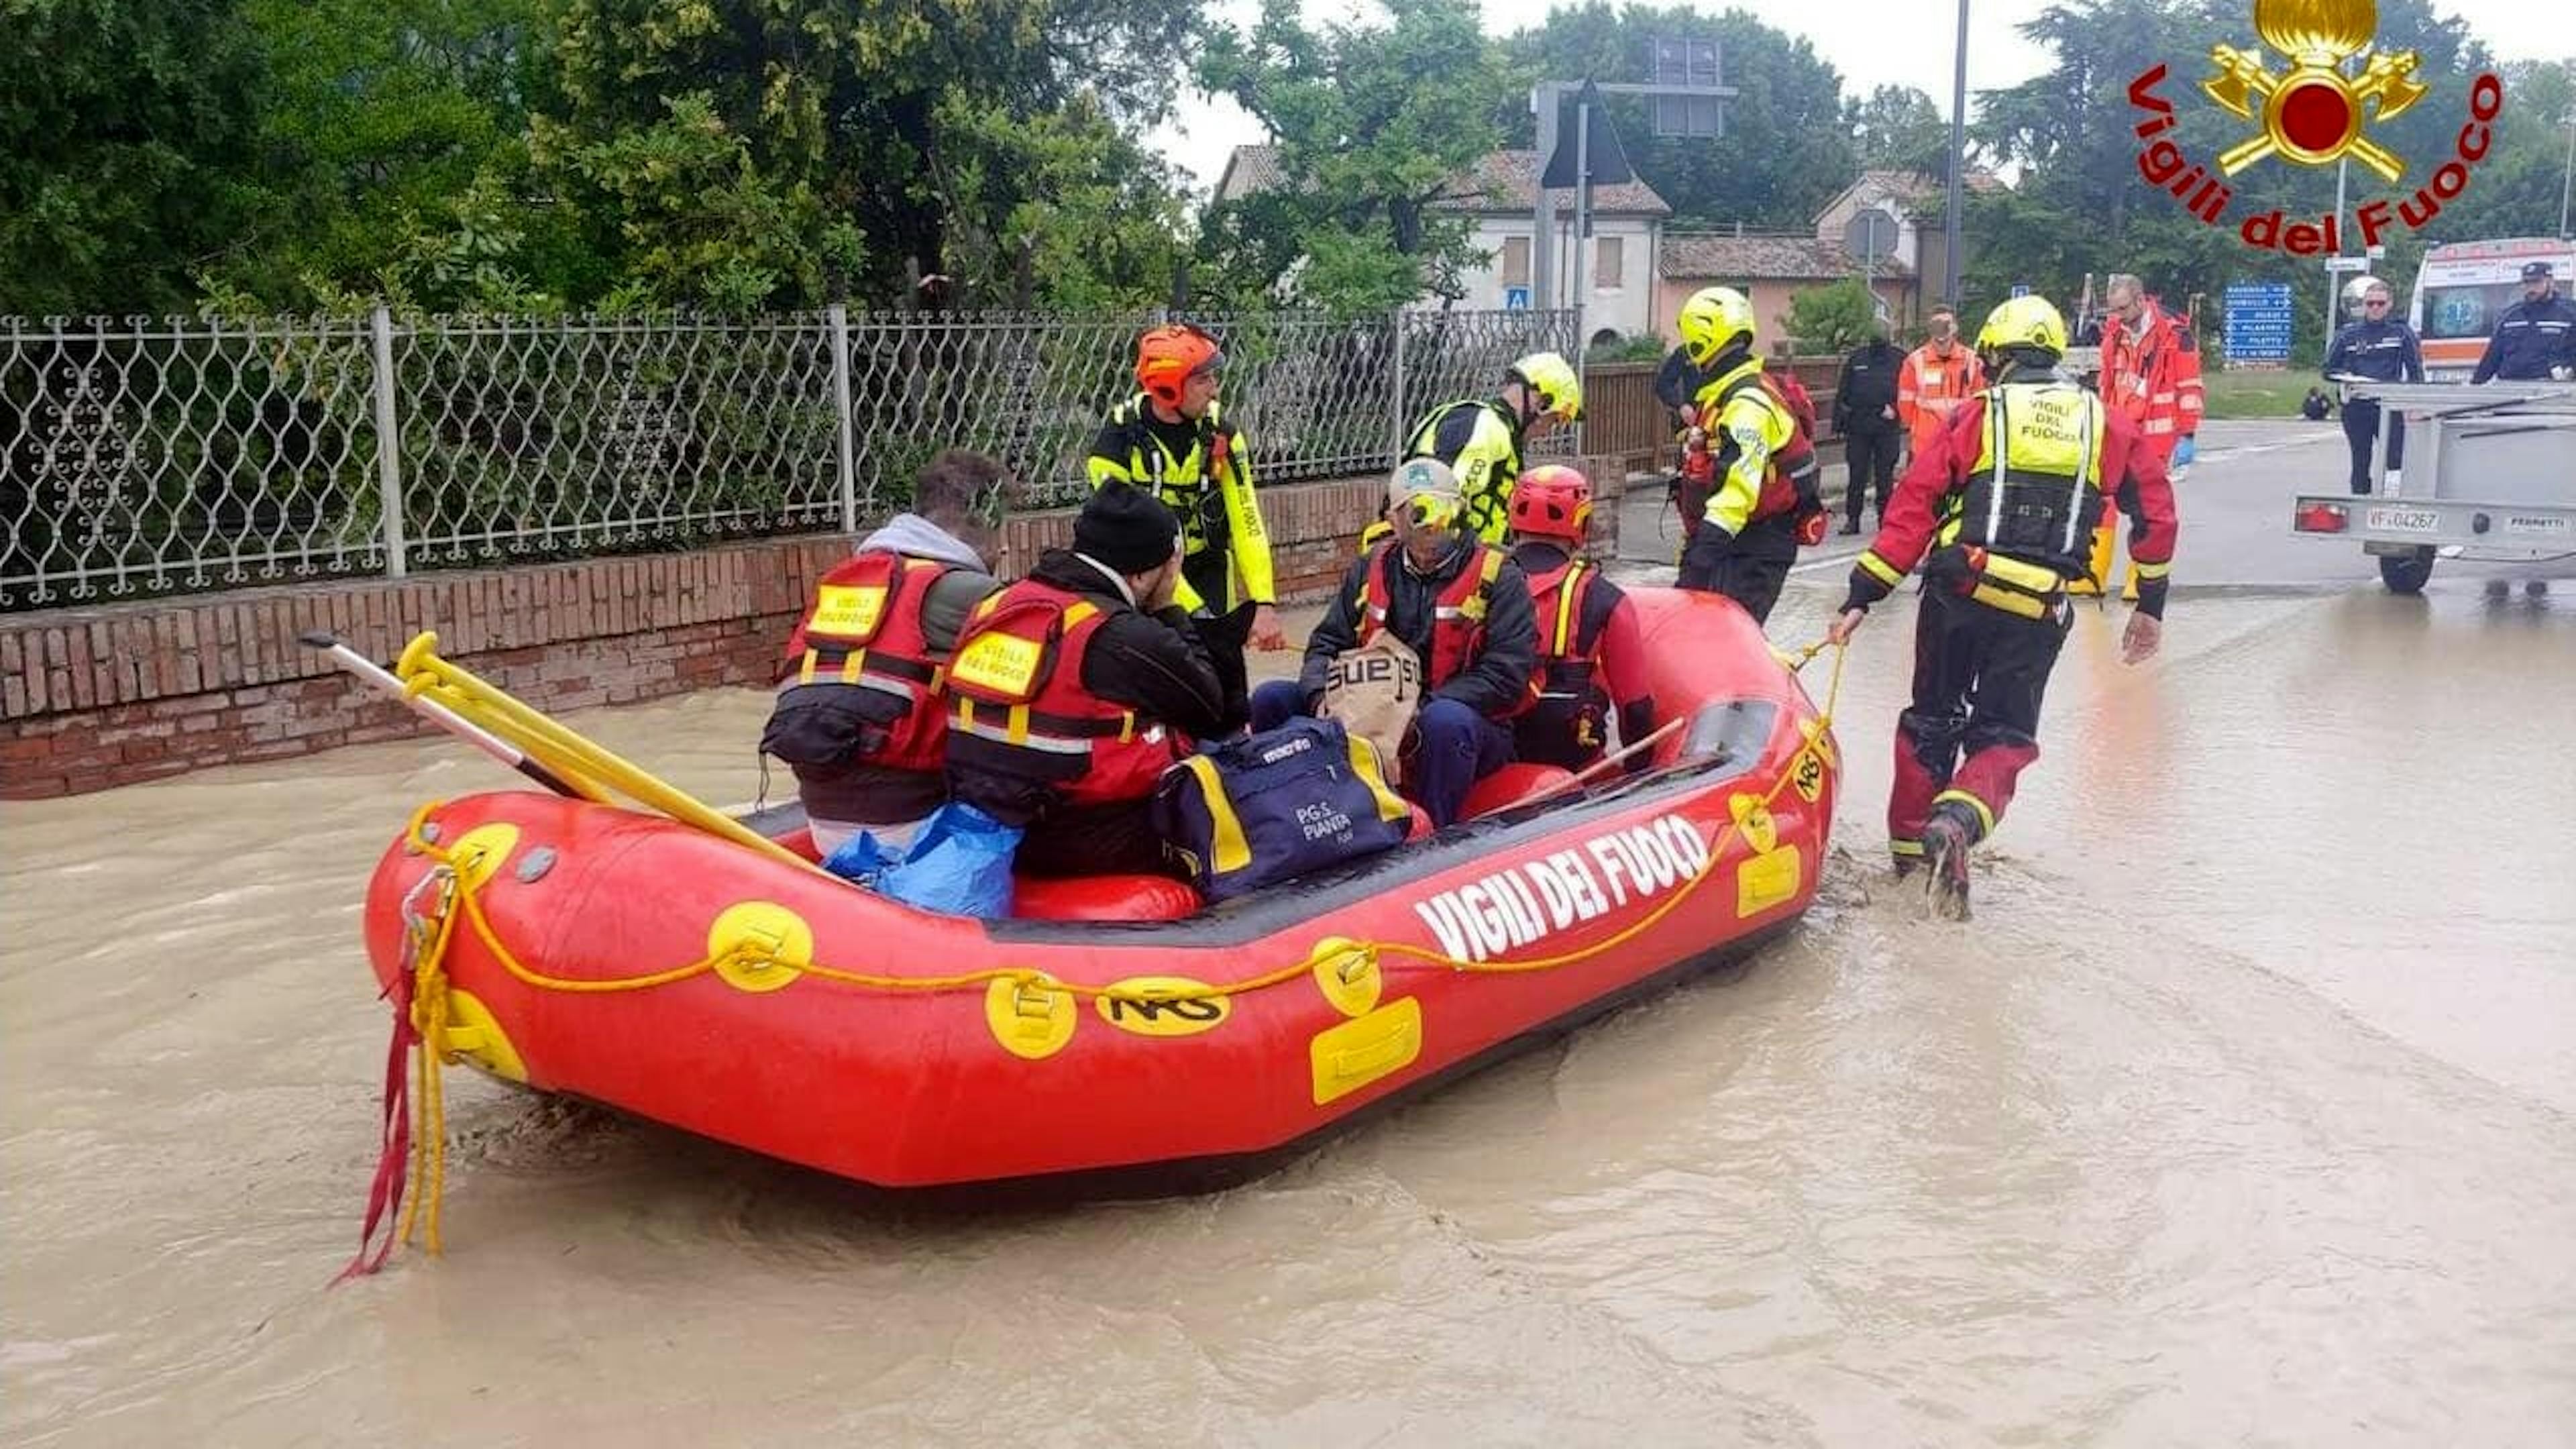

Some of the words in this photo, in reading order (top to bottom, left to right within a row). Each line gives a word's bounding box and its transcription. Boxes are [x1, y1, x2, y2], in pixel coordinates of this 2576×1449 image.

[2030, 400, 2070, 417] VIGILI
[2035, 413, 2060, 427] DEL
[2021, 425, 2076, 441] FUOCO
[2394, 513, 2436, 528] 04267
[1303, 814, 1352, 841] PIANTA
[1415, 869, 1547, 966] VIGILI
[1524, 849, 1609, 930] DEL
[1586, 814, 1709, 906] FUOCO
